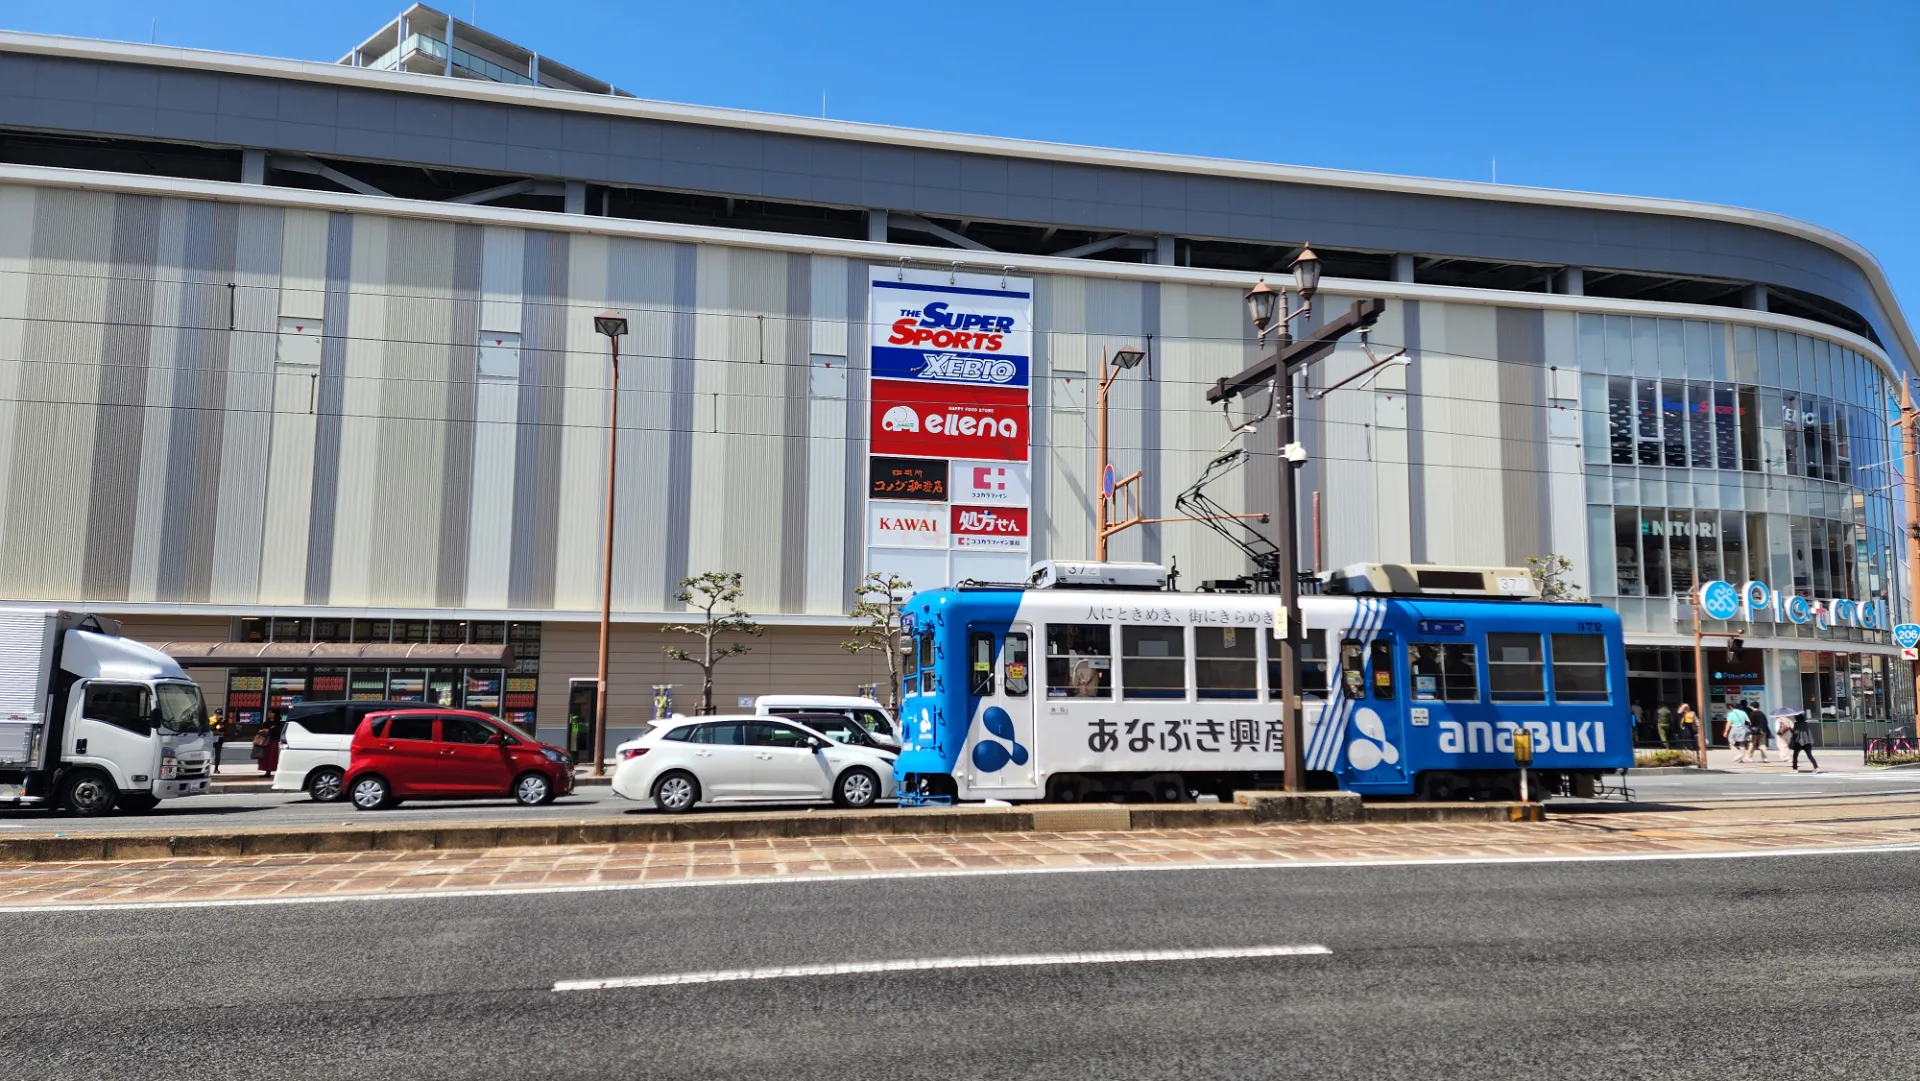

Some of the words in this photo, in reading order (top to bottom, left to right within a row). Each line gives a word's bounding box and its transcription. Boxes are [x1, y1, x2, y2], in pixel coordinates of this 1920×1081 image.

[900, 309, 922, 318] THE
[919, 302, 1015, 334] SUPER
[888, 318, 1005, 352] SPORTS
[918, 353, 1017, 383] XEBIO
[925, 413, 1018, 438] ellena
[880, 517, 937, 532] KAWAI
[959, 510, 1020, 532] 処方せん
[1652, 520, 1717, 537] NITORI
[1577, 622, 1603, 632] 372
[1898, 630, 1918, 640] 206
[1088, 719, 1284, 752] あなぶき興産
